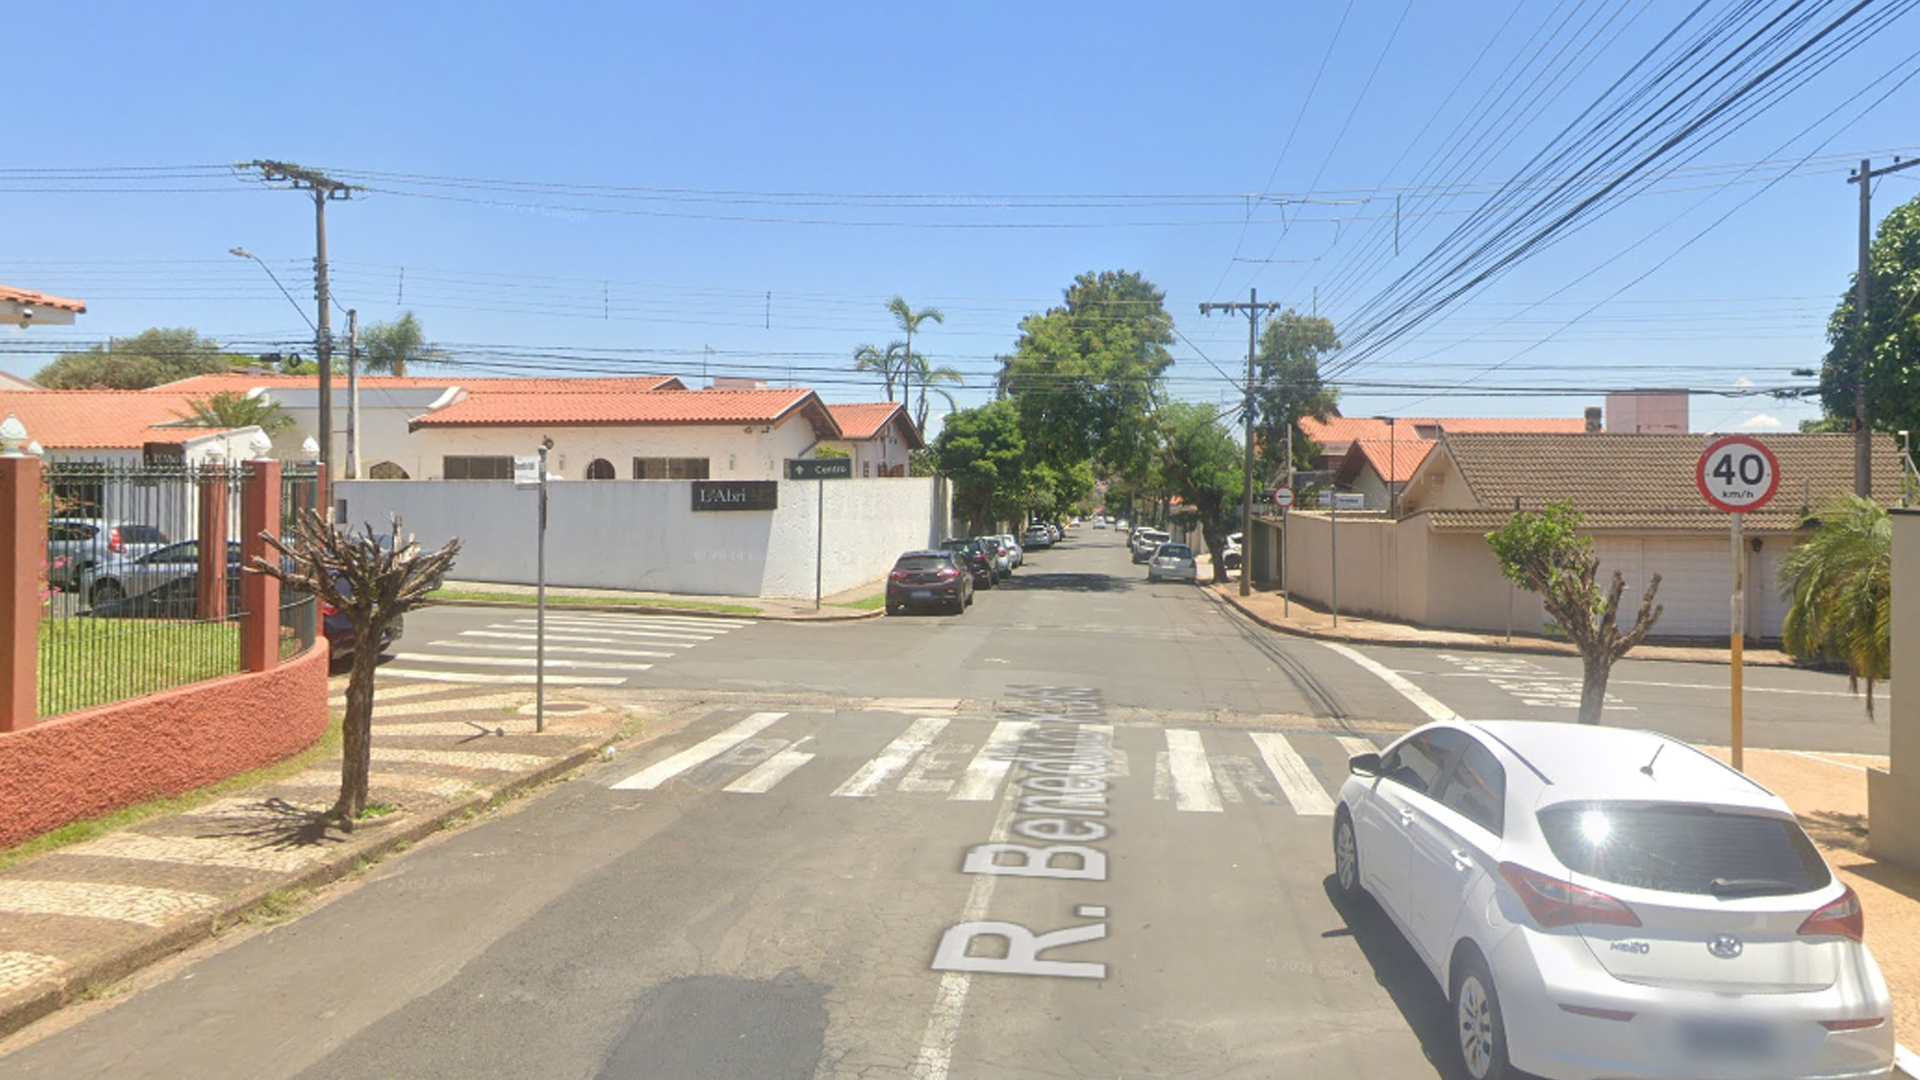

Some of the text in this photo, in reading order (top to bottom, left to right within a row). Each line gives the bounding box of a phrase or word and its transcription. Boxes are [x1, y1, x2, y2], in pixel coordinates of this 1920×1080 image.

[814, 465, 847, 475] Centro
[1713, 453, 1765, 486] 40
[1722, 489, 1754, 498] km/h
